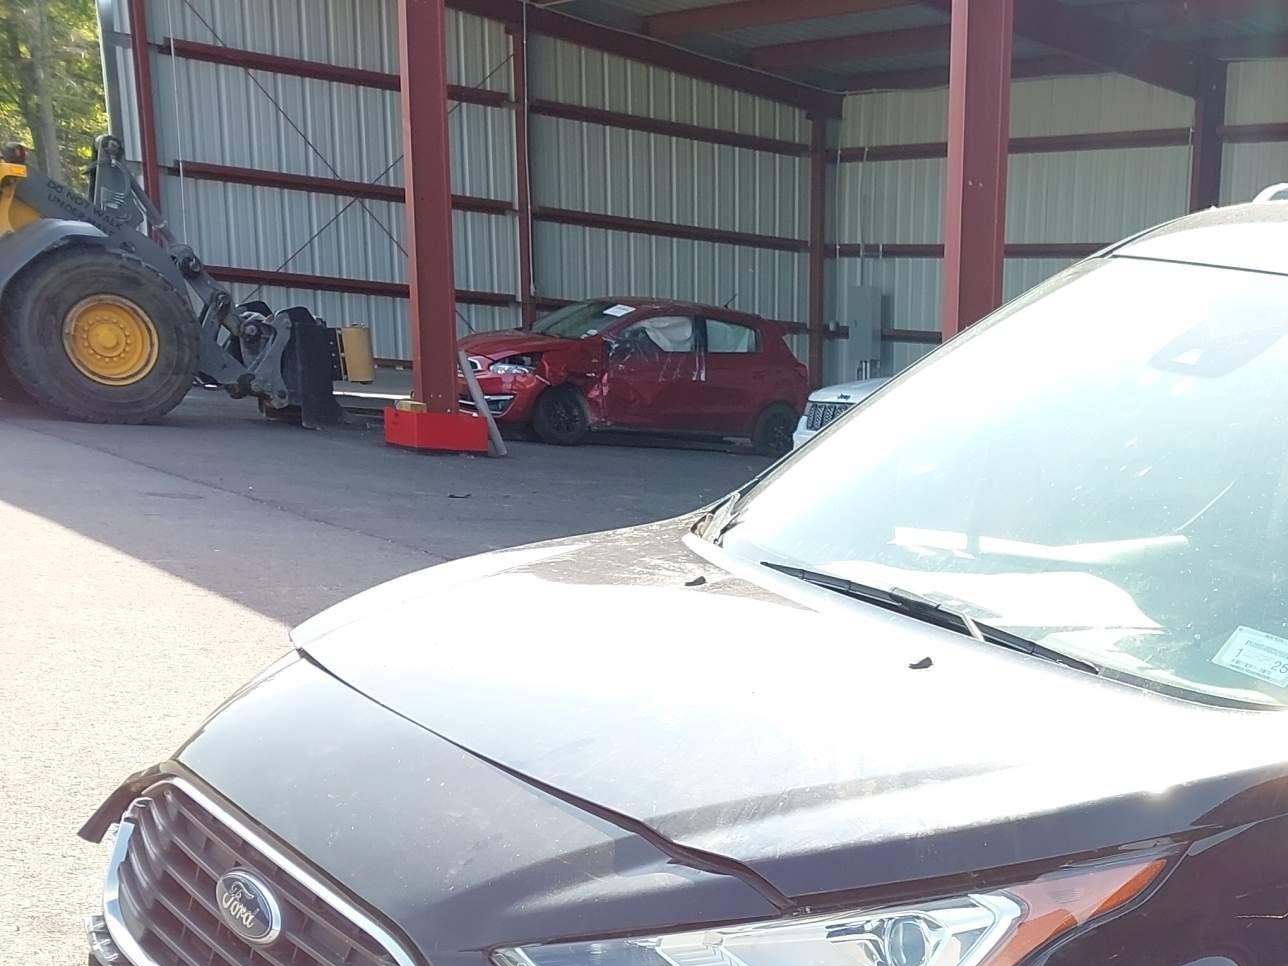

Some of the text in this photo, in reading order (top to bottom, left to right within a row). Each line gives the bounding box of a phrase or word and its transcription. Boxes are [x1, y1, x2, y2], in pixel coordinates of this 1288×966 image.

[47, 178, 64, 194] DO
[65, 191, 91, 210] NOT
[222, 880, 259, 928] Ford
